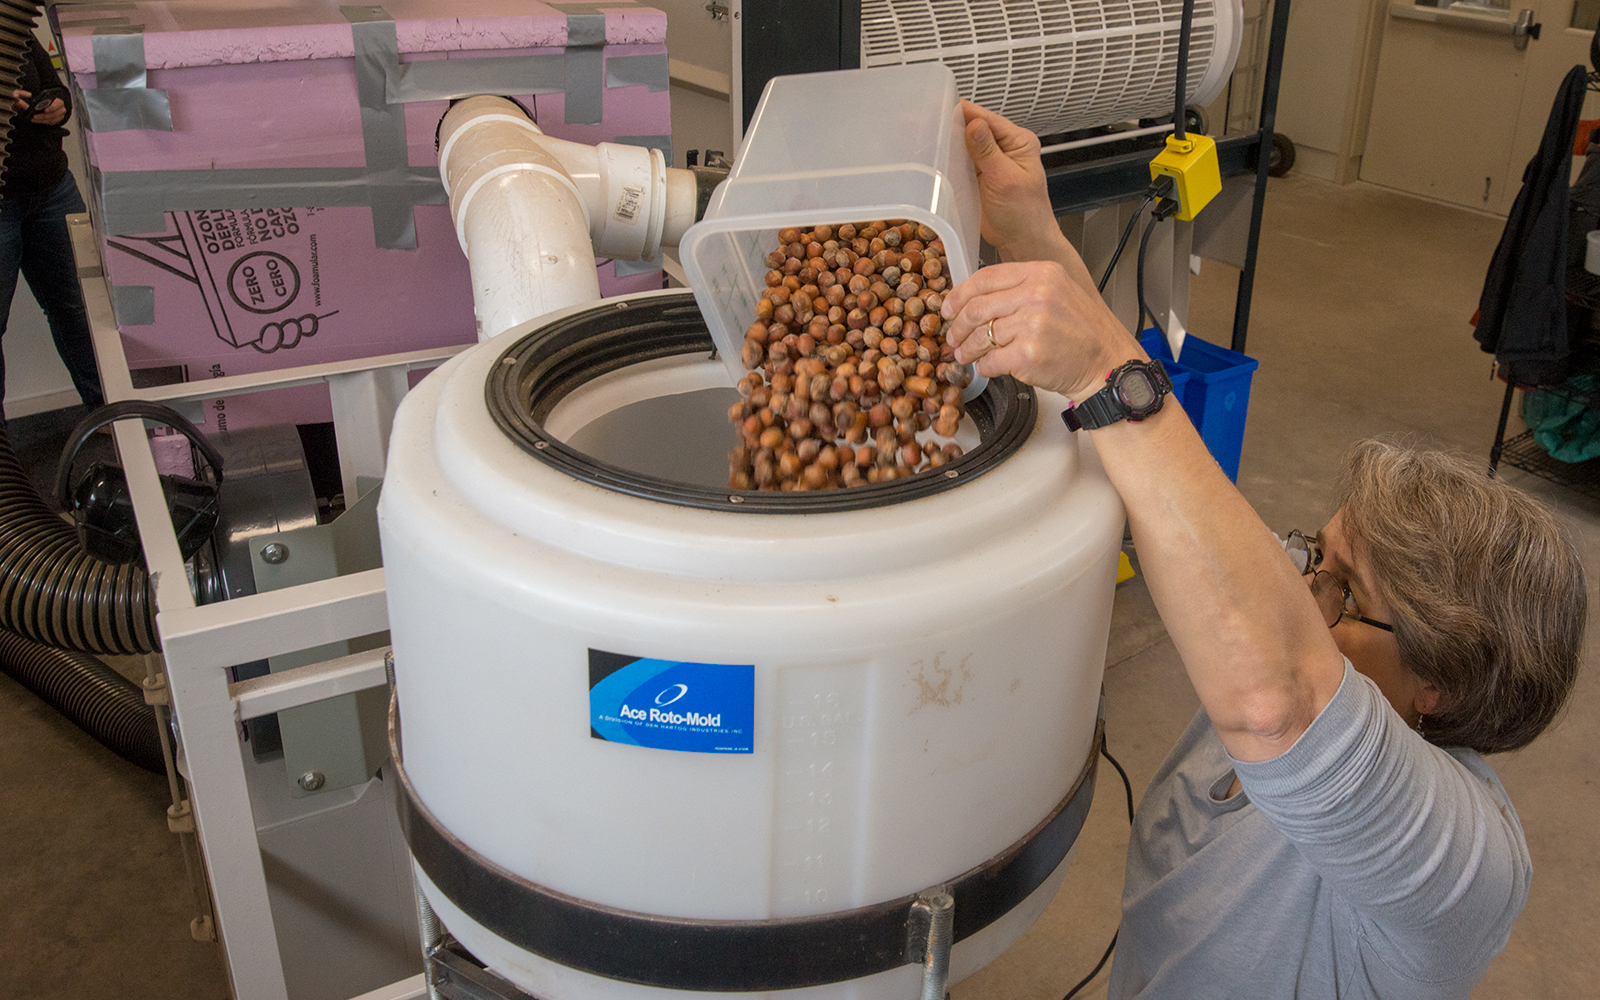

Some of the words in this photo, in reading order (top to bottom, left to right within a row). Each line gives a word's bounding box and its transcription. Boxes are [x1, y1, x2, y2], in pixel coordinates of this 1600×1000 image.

[255, 217, 272, 242] NO
[266, 208, 286, 238] CAP
[266, 259, 287, 297] CERO
[309, 233, 323, 307] www.foamular.com
[242, 266, 265, 306] ZERO
[213, 400, 225, 411] de
[620, 704, 647, 721] Ace
[650, 708, 721, 727] Roto-Mold
